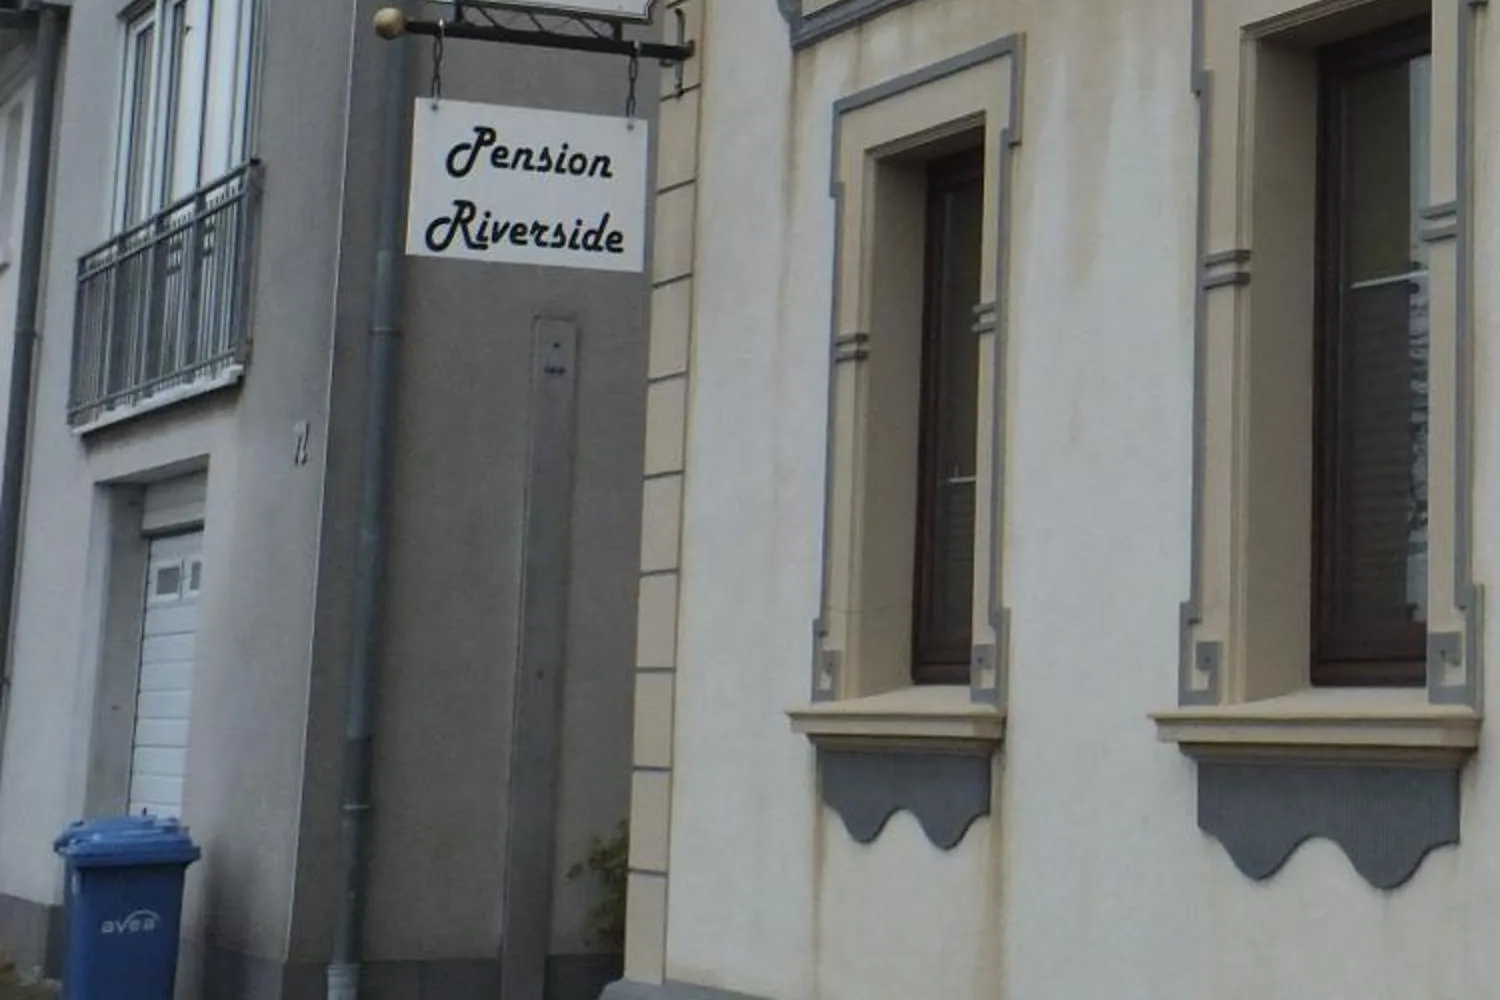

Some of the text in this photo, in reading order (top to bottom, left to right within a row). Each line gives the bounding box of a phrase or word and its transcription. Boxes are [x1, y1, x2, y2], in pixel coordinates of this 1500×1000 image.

[445, 125, 613, 179] Pension
[425, 200, 624, 253] Riverside
[101, 917, 157, 935] avea
